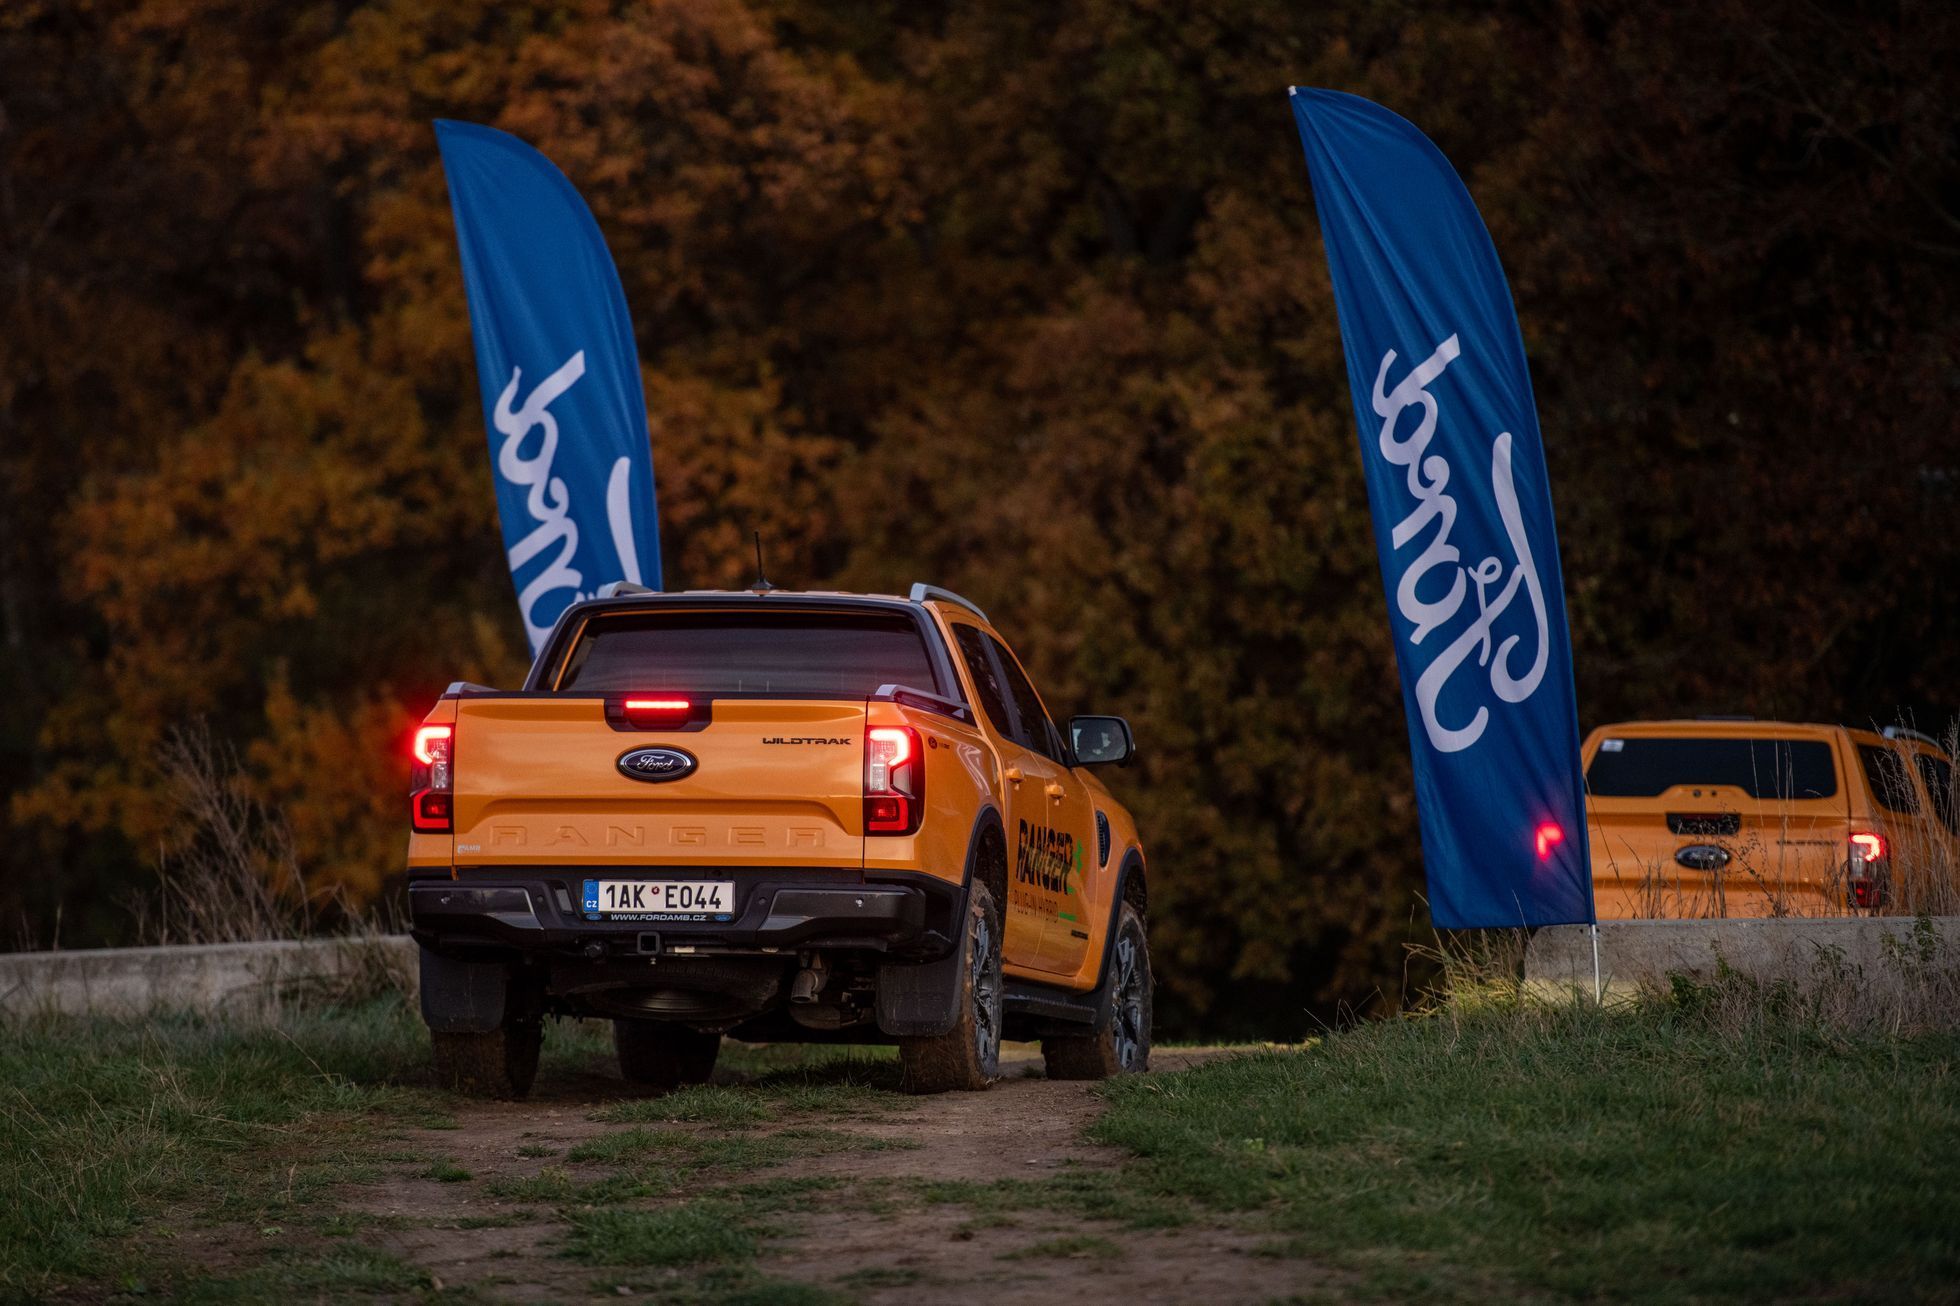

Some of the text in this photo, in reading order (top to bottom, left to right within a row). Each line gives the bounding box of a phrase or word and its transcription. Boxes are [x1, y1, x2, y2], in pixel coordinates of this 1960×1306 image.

[762, 737, 851, 745] WILDTRAK
[636, 754, 674, 771] Ford
[489, 825, 825, 848] RANGER
[1015, 817, 1074, 896] RANGER
[586, 900, 598, 908] CZ
[605, 884, 722, 909] 1AK E044
[610, 913, 708, 922] WWW.FORDAMB.CZ
